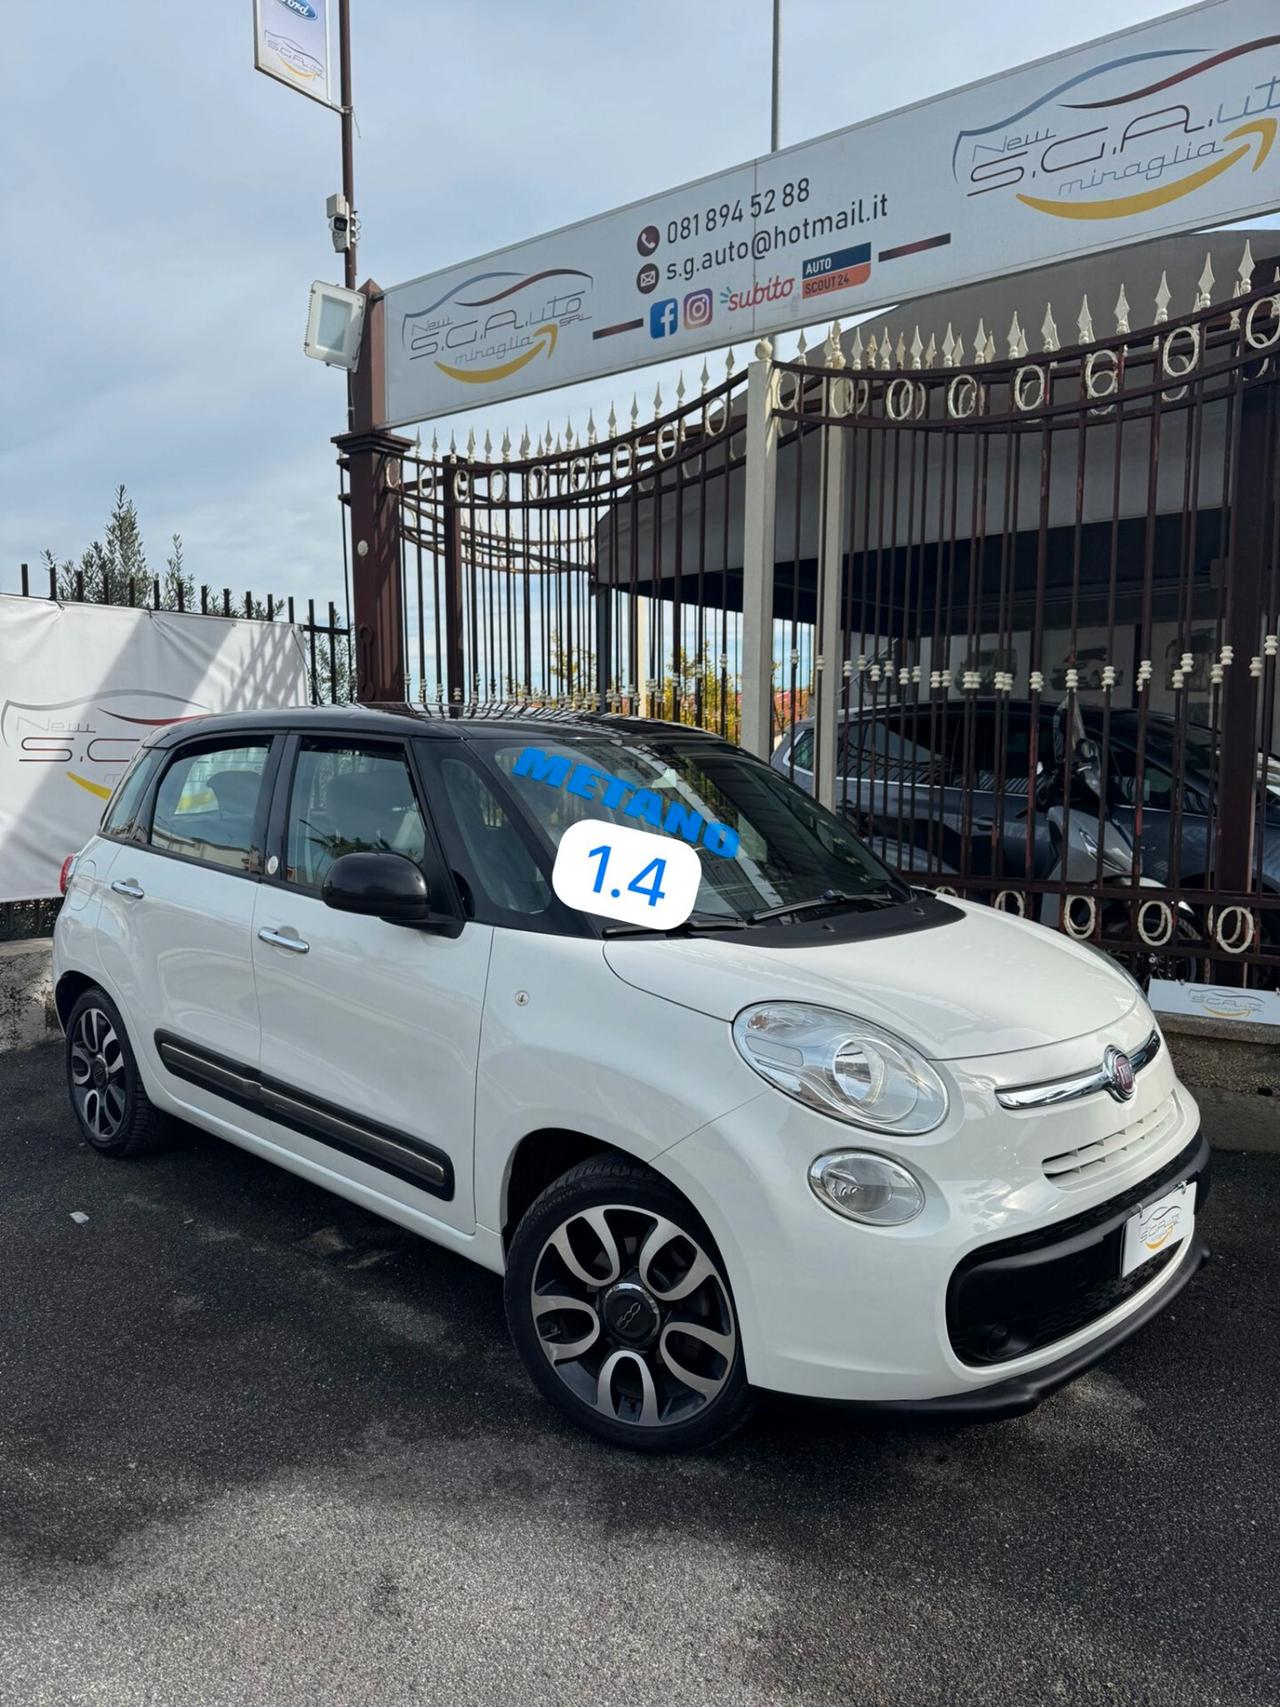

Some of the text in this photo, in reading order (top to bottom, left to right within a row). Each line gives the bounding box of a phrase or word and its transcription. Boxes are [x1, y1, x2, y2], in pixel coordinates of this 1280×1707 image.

[281, 0, 309, 15] ord
[972, 127, 1057, 162] New
[667, 177, 810, 244] 081 894 52 88
[666, 192, 889, 282] s.g.auto@hotmail.it
[805, 257, 832, 276] AUTO
[728, 275, 796, 312] subito
[805, 273, 850, 295] SCOUT 24
[411, 317, 454, 337] New
[15, 716, 97, 734] New
[511, 745, 741, 860] METANO
